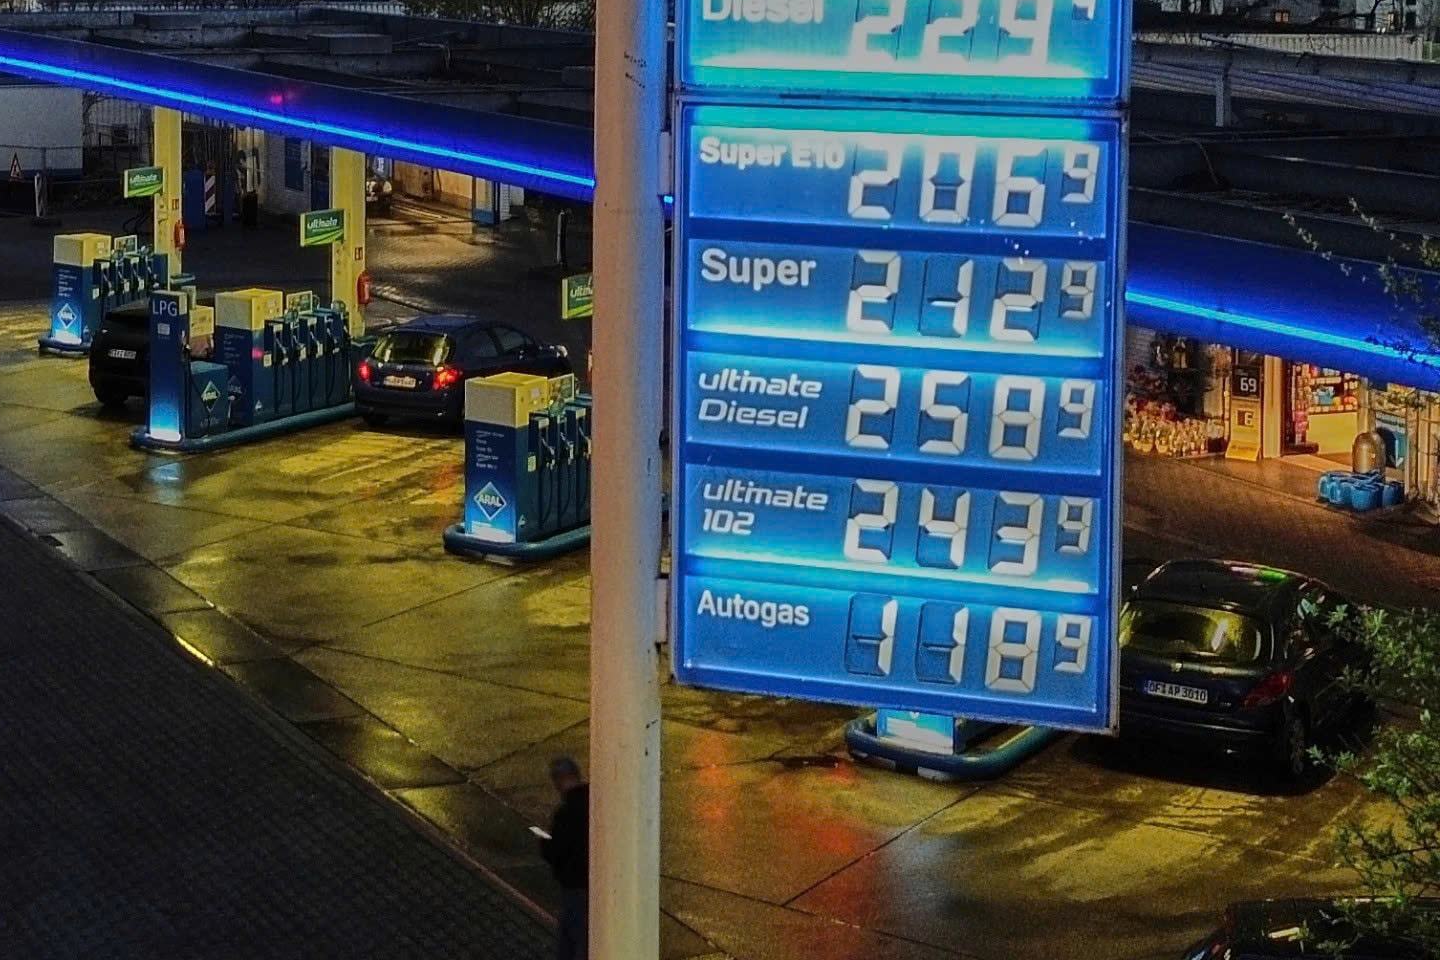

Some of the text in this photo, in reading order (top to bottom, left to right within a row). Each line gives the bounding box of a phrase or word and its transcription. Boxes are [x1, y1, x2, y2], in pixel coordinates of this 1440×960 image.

[701, 136, 786, 170] Super
[791, 139, 846, 169] E10
[701, 248, 817, 291] Super
[152, 300, 177, 317] LPG
[698, 368, 823, 398] ultimate
[1240, 377, 1257, 392] 69
[698, 399, 808, 429] Diesel
[478, 494, 502, 507] ARAL
[703, 479, 829, 510] ultimate
[702, 508, 755, 535] 102
[697, 589, 810, 628] Autogas
